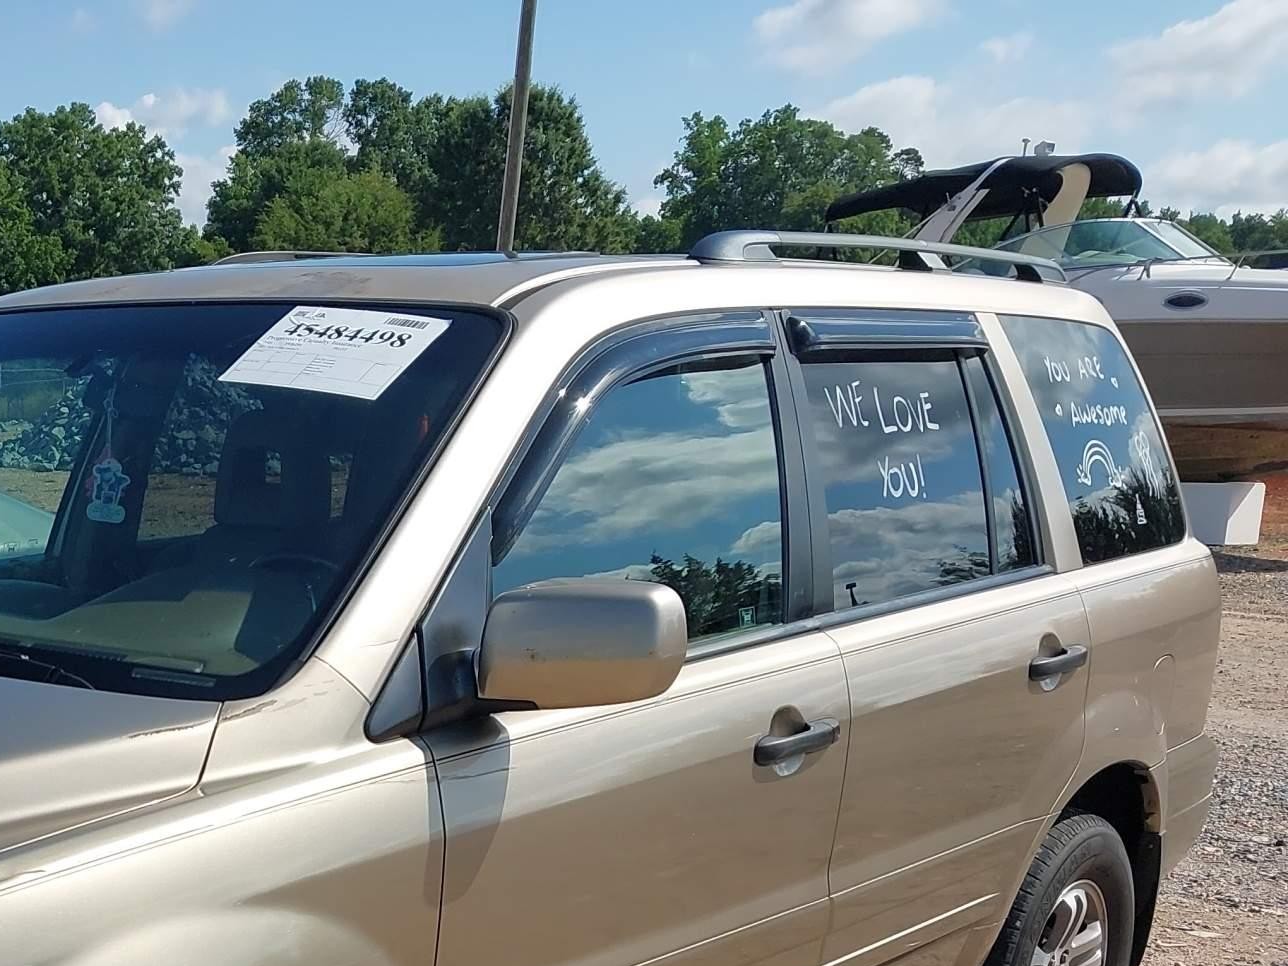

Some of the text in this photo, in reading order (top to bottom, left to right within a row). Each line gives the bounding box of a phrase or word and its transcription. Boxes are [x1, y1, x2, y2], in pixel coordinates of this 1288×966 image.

[284, 323, 412, 348] 45484498
[1044, 356, 1105, 382] YOU ARE
[824, 380, 939, 434] WE LOVE
[877, 454, 927, 499] YOU!
